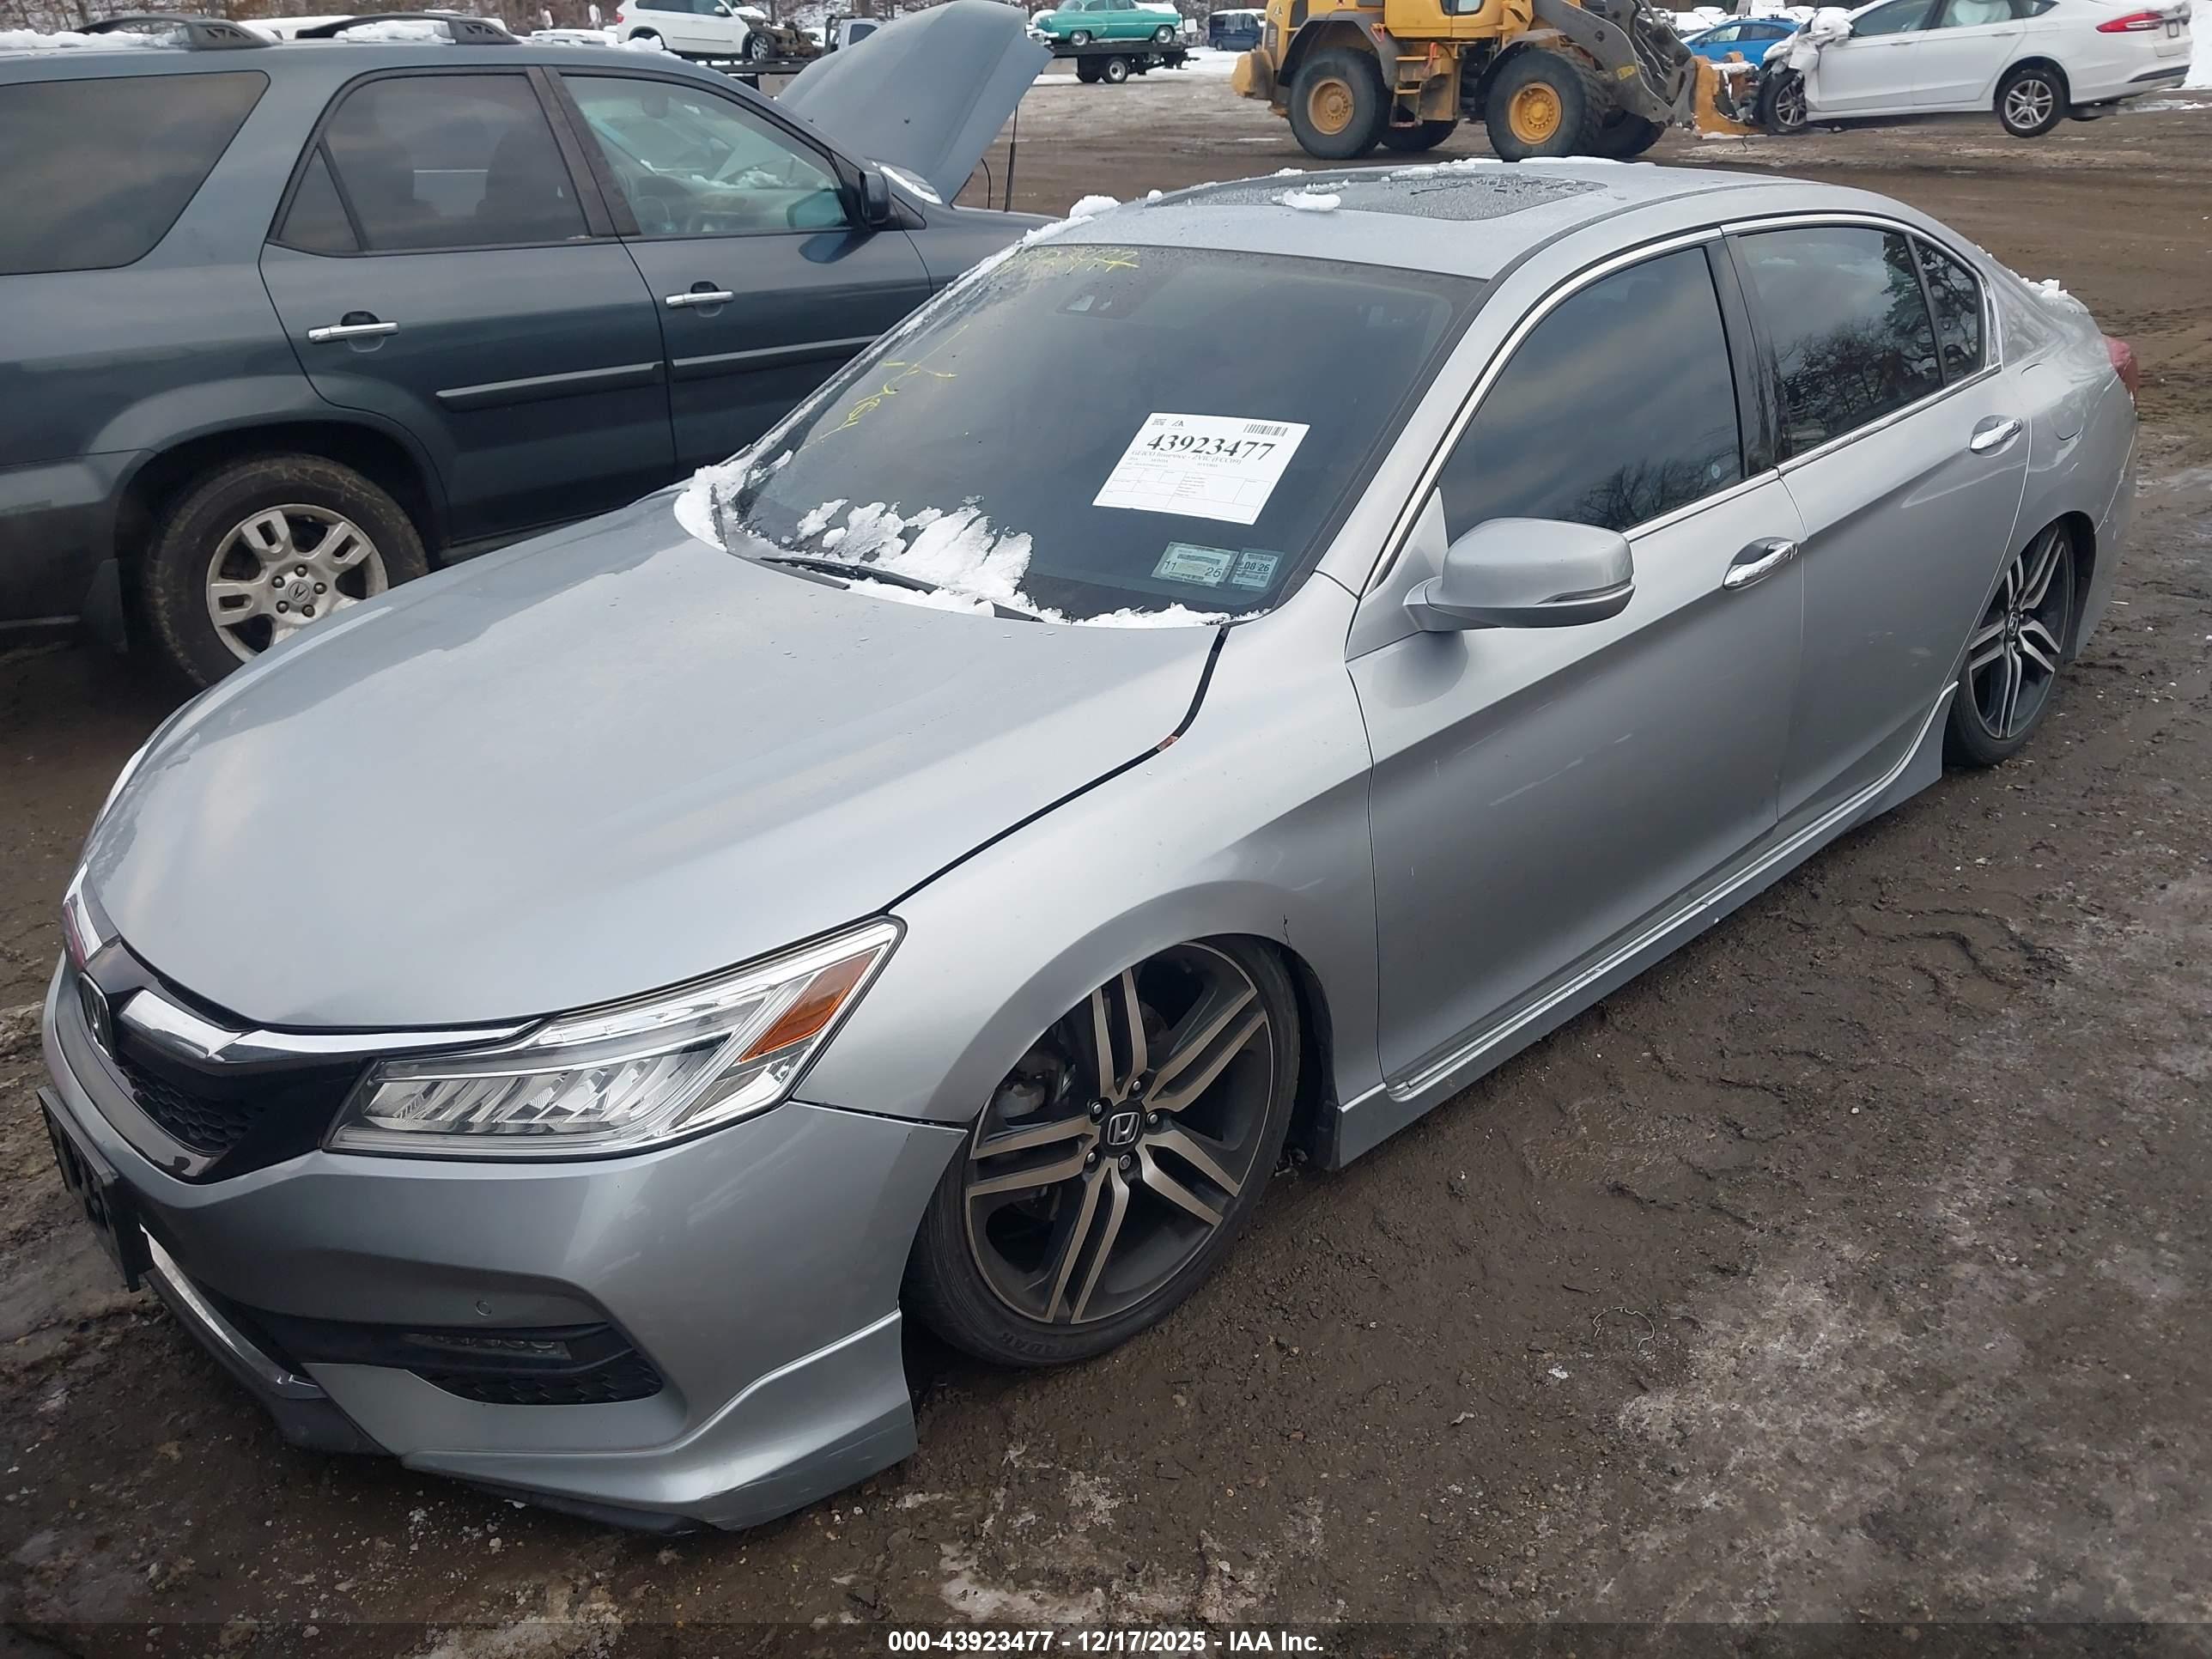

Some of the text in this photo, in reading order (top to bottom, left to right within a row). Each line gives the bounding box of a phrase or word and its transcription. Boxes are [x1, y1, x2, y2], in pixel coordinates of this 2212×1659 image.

[1147, 434, 1277, 460] 43923477
[1243, 561, 1271, 572] 08 26
[1205, 567, 1223, 578] 25
